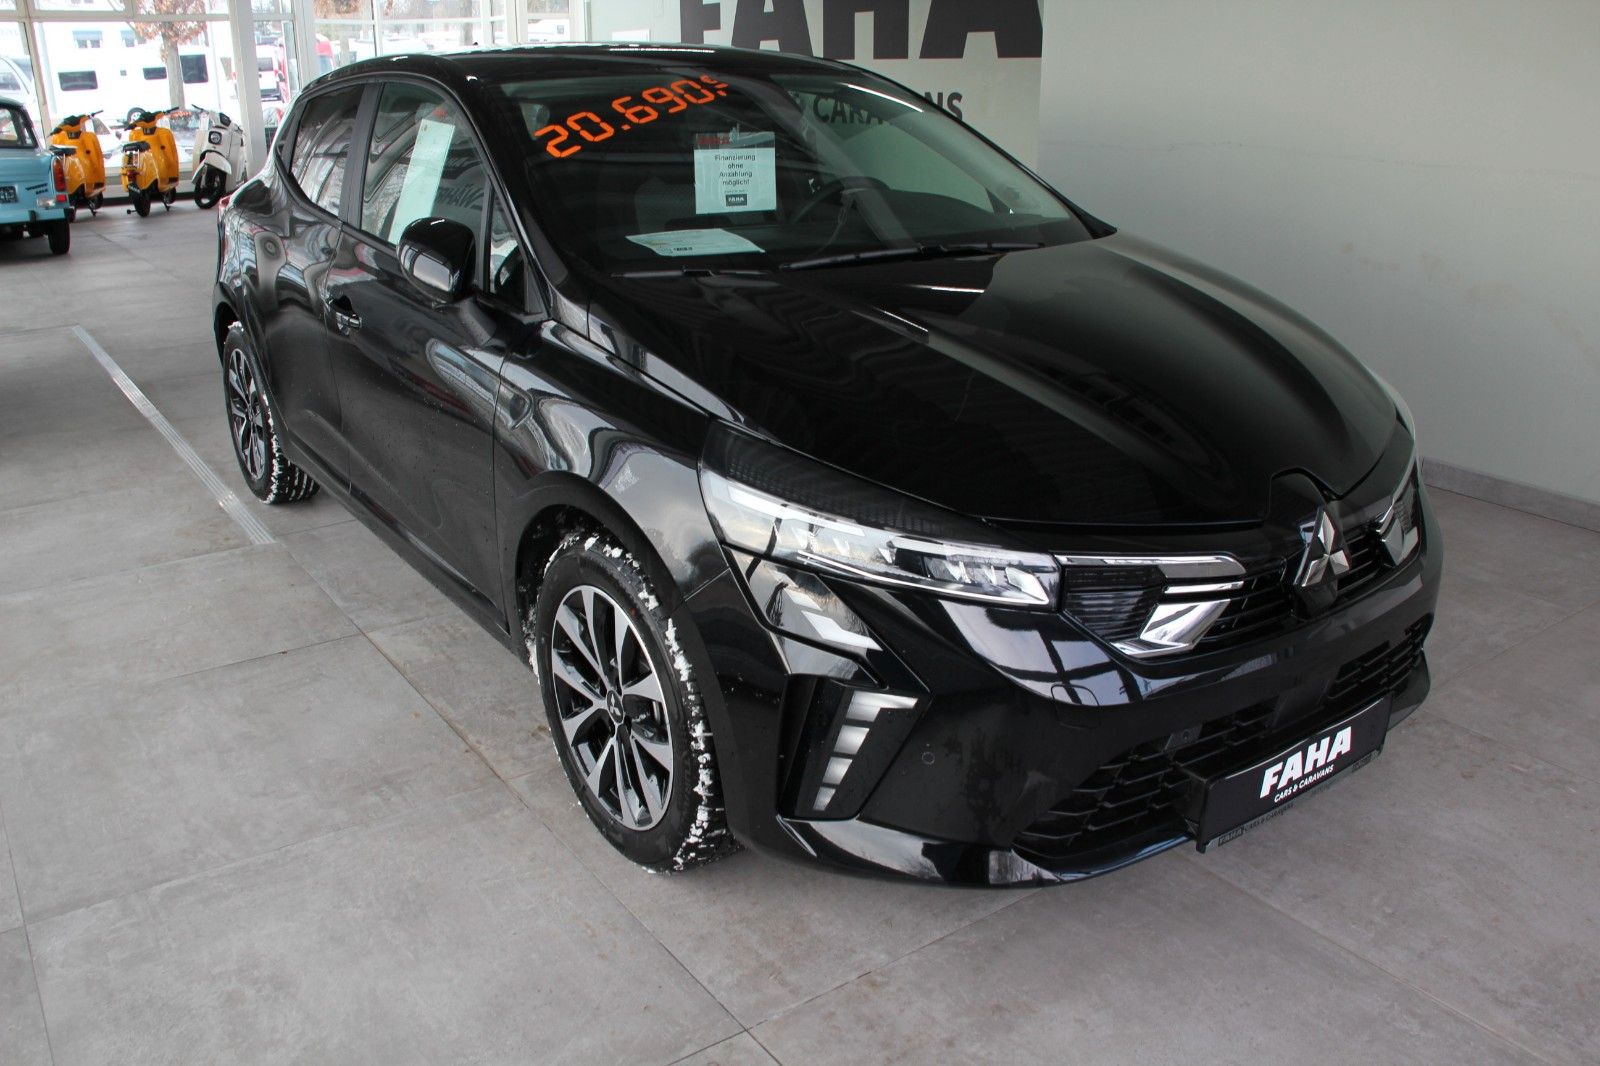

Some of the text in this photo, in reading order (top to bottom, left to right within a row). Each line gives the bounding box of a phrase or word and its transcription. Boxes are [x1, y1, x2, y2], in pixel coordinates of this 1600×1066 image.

[812, 91, 963, 126] CARNS
[1260, 726, 1352, 799] FAHA
[1274, 786, 1292, 803] CARS
[1292, 783, 1298, 793] &
[1299, 764, 1334, 789] CARAVANS
